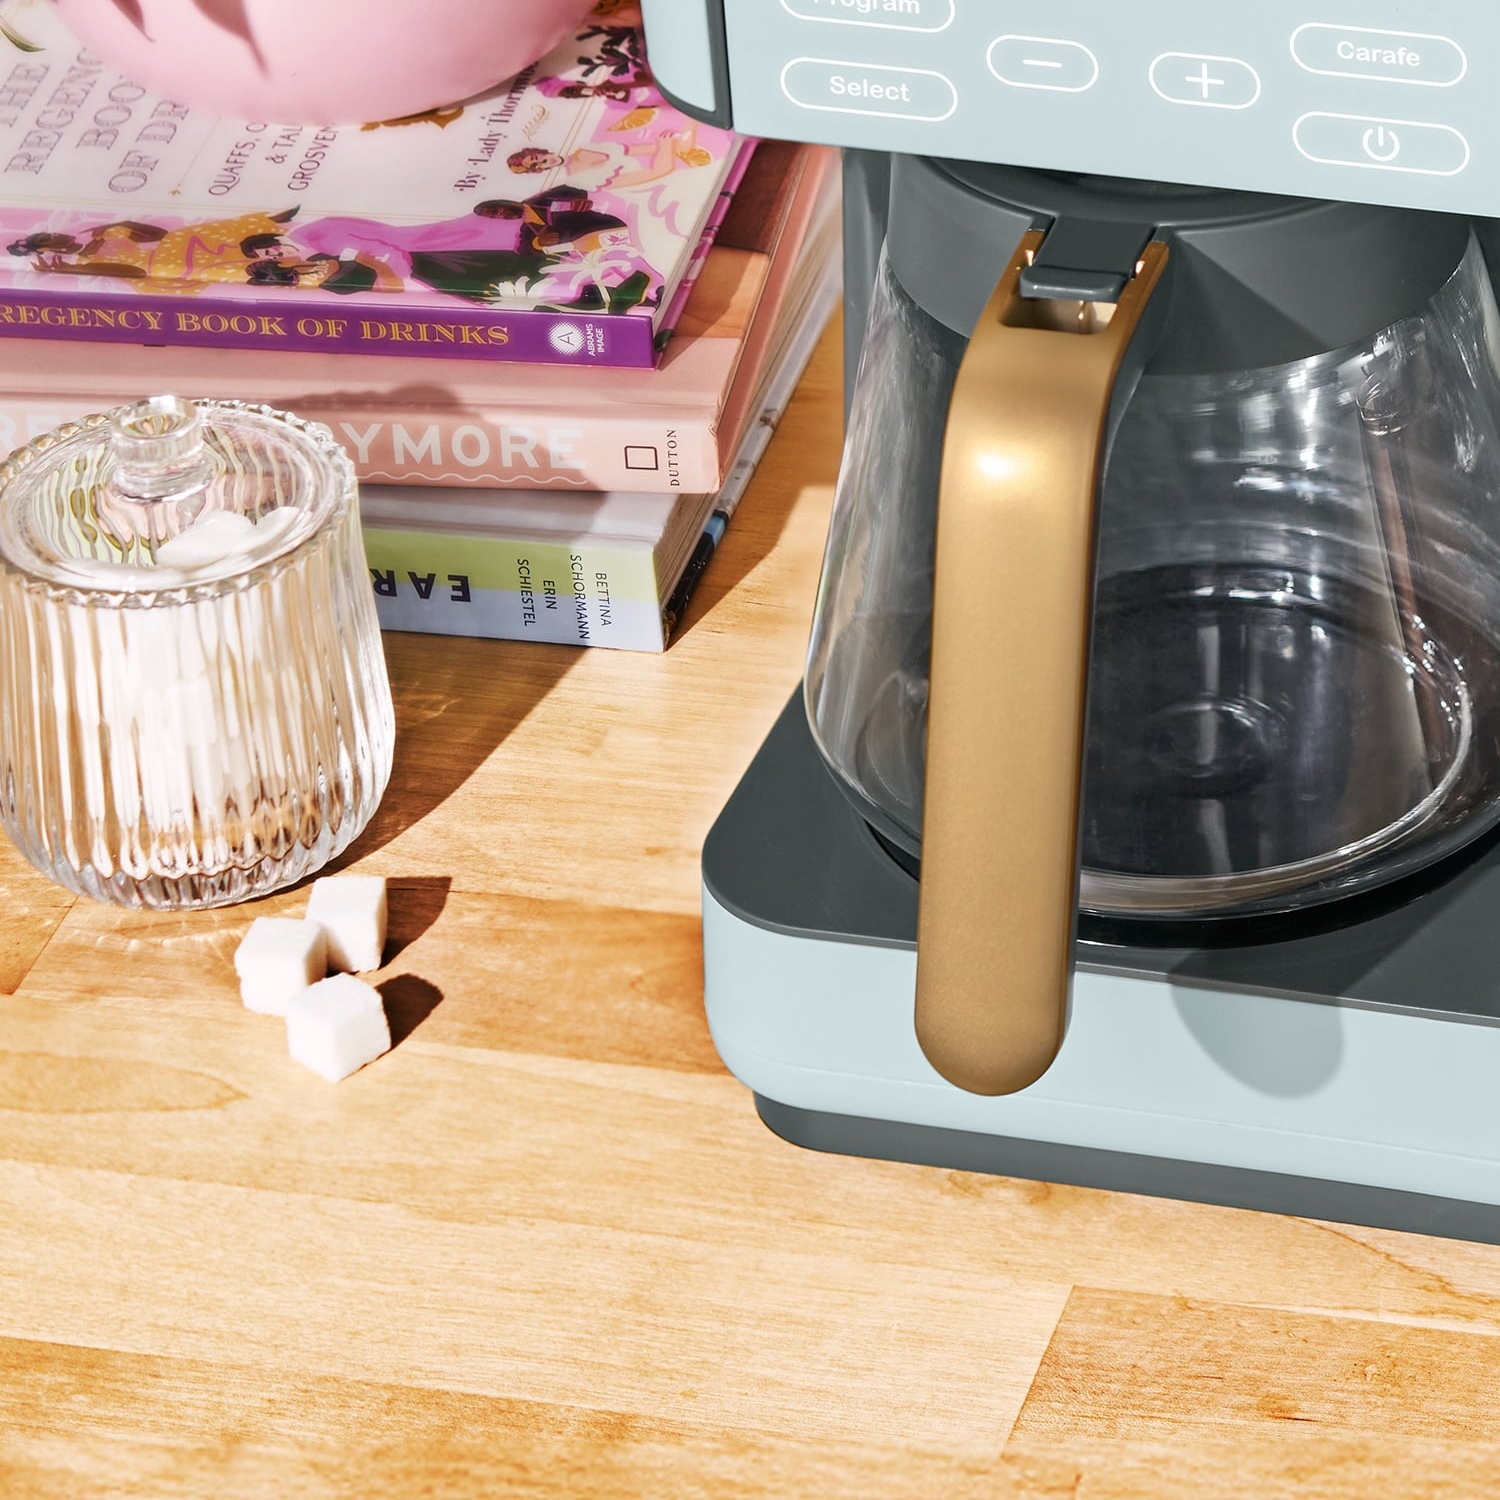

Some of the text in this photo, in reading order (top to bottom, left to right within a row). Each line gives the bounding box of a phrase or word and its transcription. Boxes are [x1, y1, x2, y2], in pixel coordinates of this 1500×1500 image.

[1336, 40, 1421, 69] Carafe
[829, 74, 911, 103] Select
[467, 129, 509, 167] Lady
[108, 150, 160, 193] OF
[453, 171, 487, 193] By
[176, 311, 288, 337] BOOK
[296, 317, 349, 339] OF
[359, 320, 511, 346] DRINKS
[585, 323, 596, 358] ABRAMS
[597, 327, 605, 353] IMAGE
[320, 421, 588, 470] YMORE
[666, 429, 682, 487] DUTTON
[517, 558, 537, 628] SCHIESTEL
[543, 579, 558, 611] ERIN
[570, 554, 591, 640] SCHORMANN
[595, 572, 613, 627] BETTINA
